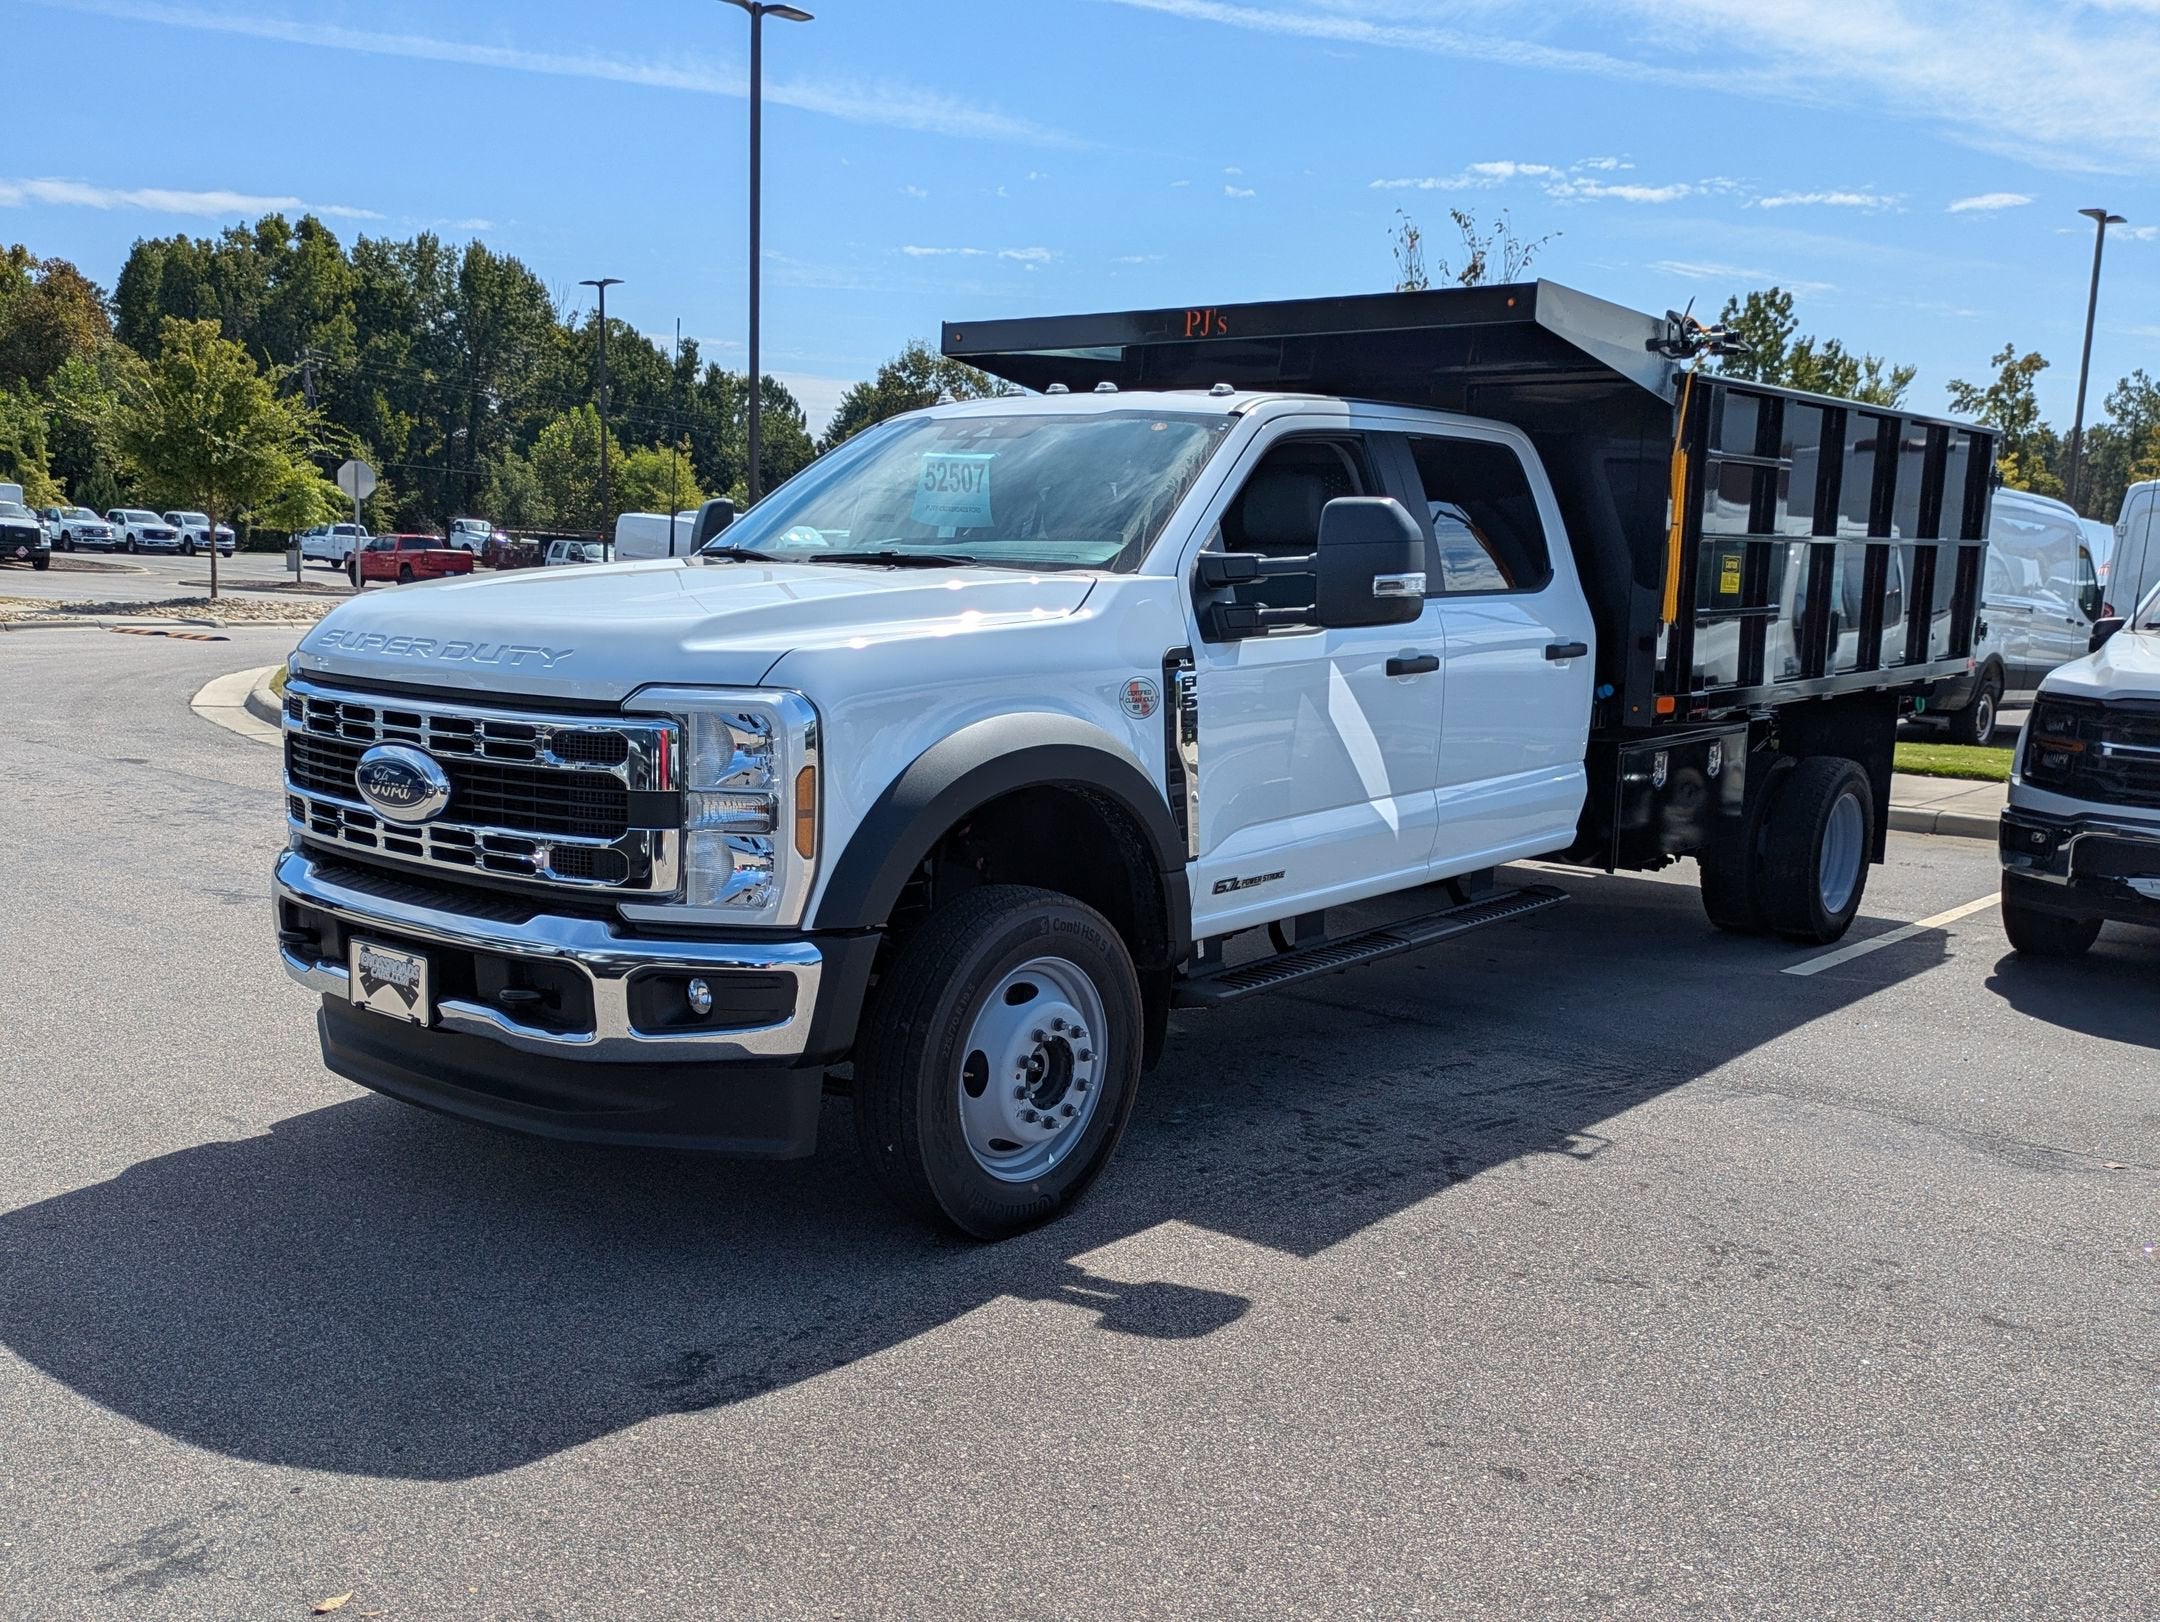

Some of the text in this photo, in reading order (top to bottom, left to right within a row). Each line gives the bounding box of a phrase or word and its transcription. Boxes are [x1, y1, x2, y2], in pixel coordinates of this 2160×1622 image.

[1184, 308, 1228, 337] PJ's
[924, 462, 986, 494] 52507
[317, 629, 575, 668] SUPER DUTY
[369, 766, 411, 800] Ford
[1052, 917, 1081, 935] Conti
